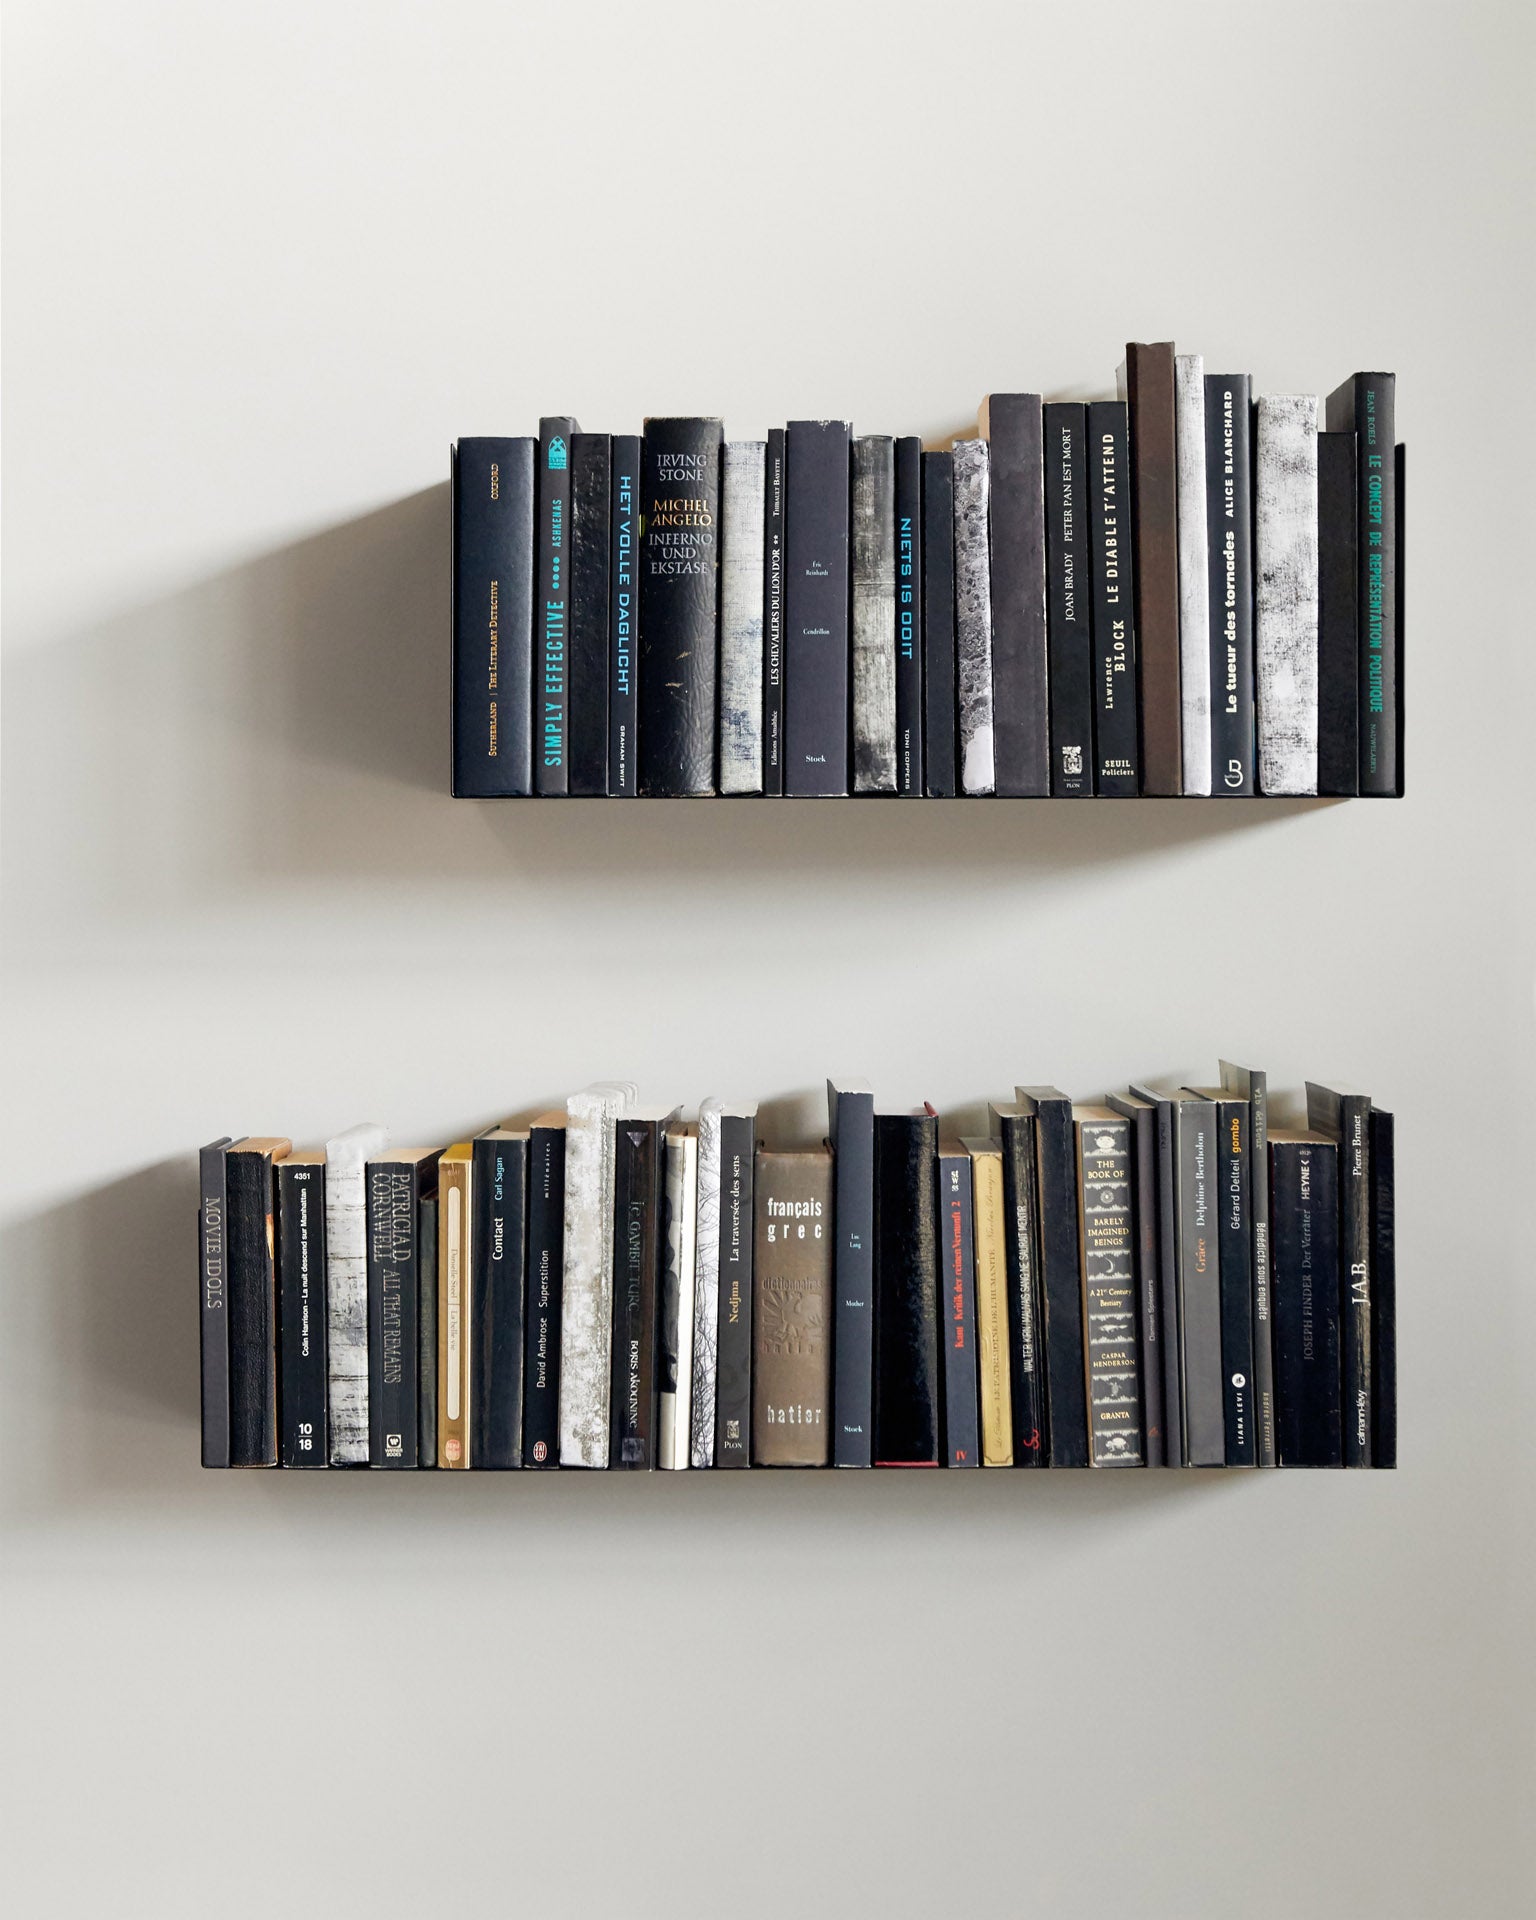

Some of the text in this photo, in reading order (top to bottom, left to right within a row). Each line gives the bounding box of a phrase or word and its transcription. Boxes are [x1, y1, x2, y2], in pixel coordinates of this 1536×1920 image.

[1367, 390, 1376, 445] JEAN ROELS
[657, 454, 707, 467] IRVING
[1223, 391, 1234, 518] ALICE BLANCHARD
[491, 463, 500, 500] OXFORD
[659, 469, 704, 482] STONE
[651, 513, 712, 527] ANGELO
[653, 499, 709, 512] MICHEL
[552, 499, 562, 547] ASHKENAS
[1062, 426, 1076, 622] JOAN BRADY PETER PAN EST MORT
[649, 532, 713, 546] INFERNO
[662, 547, 697, 559] UND
[1104, 517, 1118, 578] DIABLE
[651, 561, 708, 575] EKSTASE
[618, 476, 631, 695] HET VOLLE DAGLICHT
[771, 571, 780, 595] LION
[900, 517, 913, 660] NIETS IS OOIT
[1107, 585, 1119, 603] LE
[1369, 455, 1385, 712] LE CONCEPT DE REPRÉSENTATION POLITIQUE
[771, 595, 780, 609] DU
[1223, 530, 1237, 713] Le tueur des tornades
[771, 611, 780, 667] CHEVALIERS
[1113, 620, 1126, 672] BLOCK
[544, 601, 564, 766] SIMPLY EFFECTIVE
[770, 668, 779, 685] LES
[1104, 656, 1114, 709] Lawrence
[805, 754, 826, 763] Stock
[1101, 768, 1135, 776] Policiers
[1105, 760, 1131, 768] SEUIL
[1230, 1118, 1242, 1153] gombo
[1255, 1110, 1264, 1150] éditeur
[1352, 1114, 1362, 1176] Pierre Brunet
[293, 1172, 311, 1180] 4351
[495, 1157, 505, 1201] Carl Sagan
[1087, 1169, 1125, 1179] BOOK OF
[1096, 1160, 1115, 1169] THE
[1230, 1159, 1241, 1230] Gérard Delteil
[1300, 1166, 1310, 1200] HEYNE
[299, 1188, 307, 1227] Manhattan
[391, 1173, 411, 1246] PATRICIA
[729, 1155, 740, 1262] La traversée des sens
[767, 1197, 822, 1219] français
[1194, 1132, 1208, 1273] Grâce Delphine Bertholon
[371, 1172, 392, 1263] CORNWELL
[951, 1212, 962, 1250] Vernunft
[1016, 1205, 1027, 1231] MENTIR
[1087, 1227, 1130, 1237] IMAGINED
[1094, 1217, 1124, 1227] BARELY
[206, 1196, 222, 1309] MOVIE IDOLS
[492, 1217, 504, 1261] Contact
[1094, 1238, 1123, 1247] BEINGS
[300, 1241, 308, 1273] descend
[953, 1250, 962, 1277] reinen
[1256, 1222, 1268, 1320] Bénédicte sous enquête
[1301, 1251, 1312, 1269] Der
[301, 1288, 308, 1299] La
[538, 1250, 550, 1308] Superstition
[953, 1279, 963, 1293] der
[1019, 1274, 1030, 1293] SANG
[1089, 1287, 1132, 1297] A Century
[1350, 1259, 1372, 1307] J.A.B.
[729, 1280, 742, 1324] Nedjma
[953, 1293, 964, 1321] Kritik
[1099, 1299, 1123, 1308] Bestiary
[1302, 1274, 1313, 1317] FINDER
[301, 1305, 309, 1336] Harrison
[383, 1268, 402, 1384] ALL THAT REMAINS
[301, 1337, 309, 1357] Colin
[954, 1326, 965, 1349] Kant
[1302, 1320, 1315, 1361] JOSEPH
[537, 1317, 548, 1388] David Ambrose
[629, 1340, 639, 1370] BORIS
[1022, 1344, 1033, 1373] WALTER
[1093, 1359, 1136, 1368] HENDERSON
[1101, 1352, 1127, 1360] CASPAR
[767, 1404, 821, 1424] hatier
[1100, 1410, 1130, 1420] GRANTA
[1355, 1389, 1368, 1446] calmann-lévy
[298, 1423, 313, 1435] 10
[844, 1425, 863, 1433] Stock
[298, 1438, 313, 1451] 18
